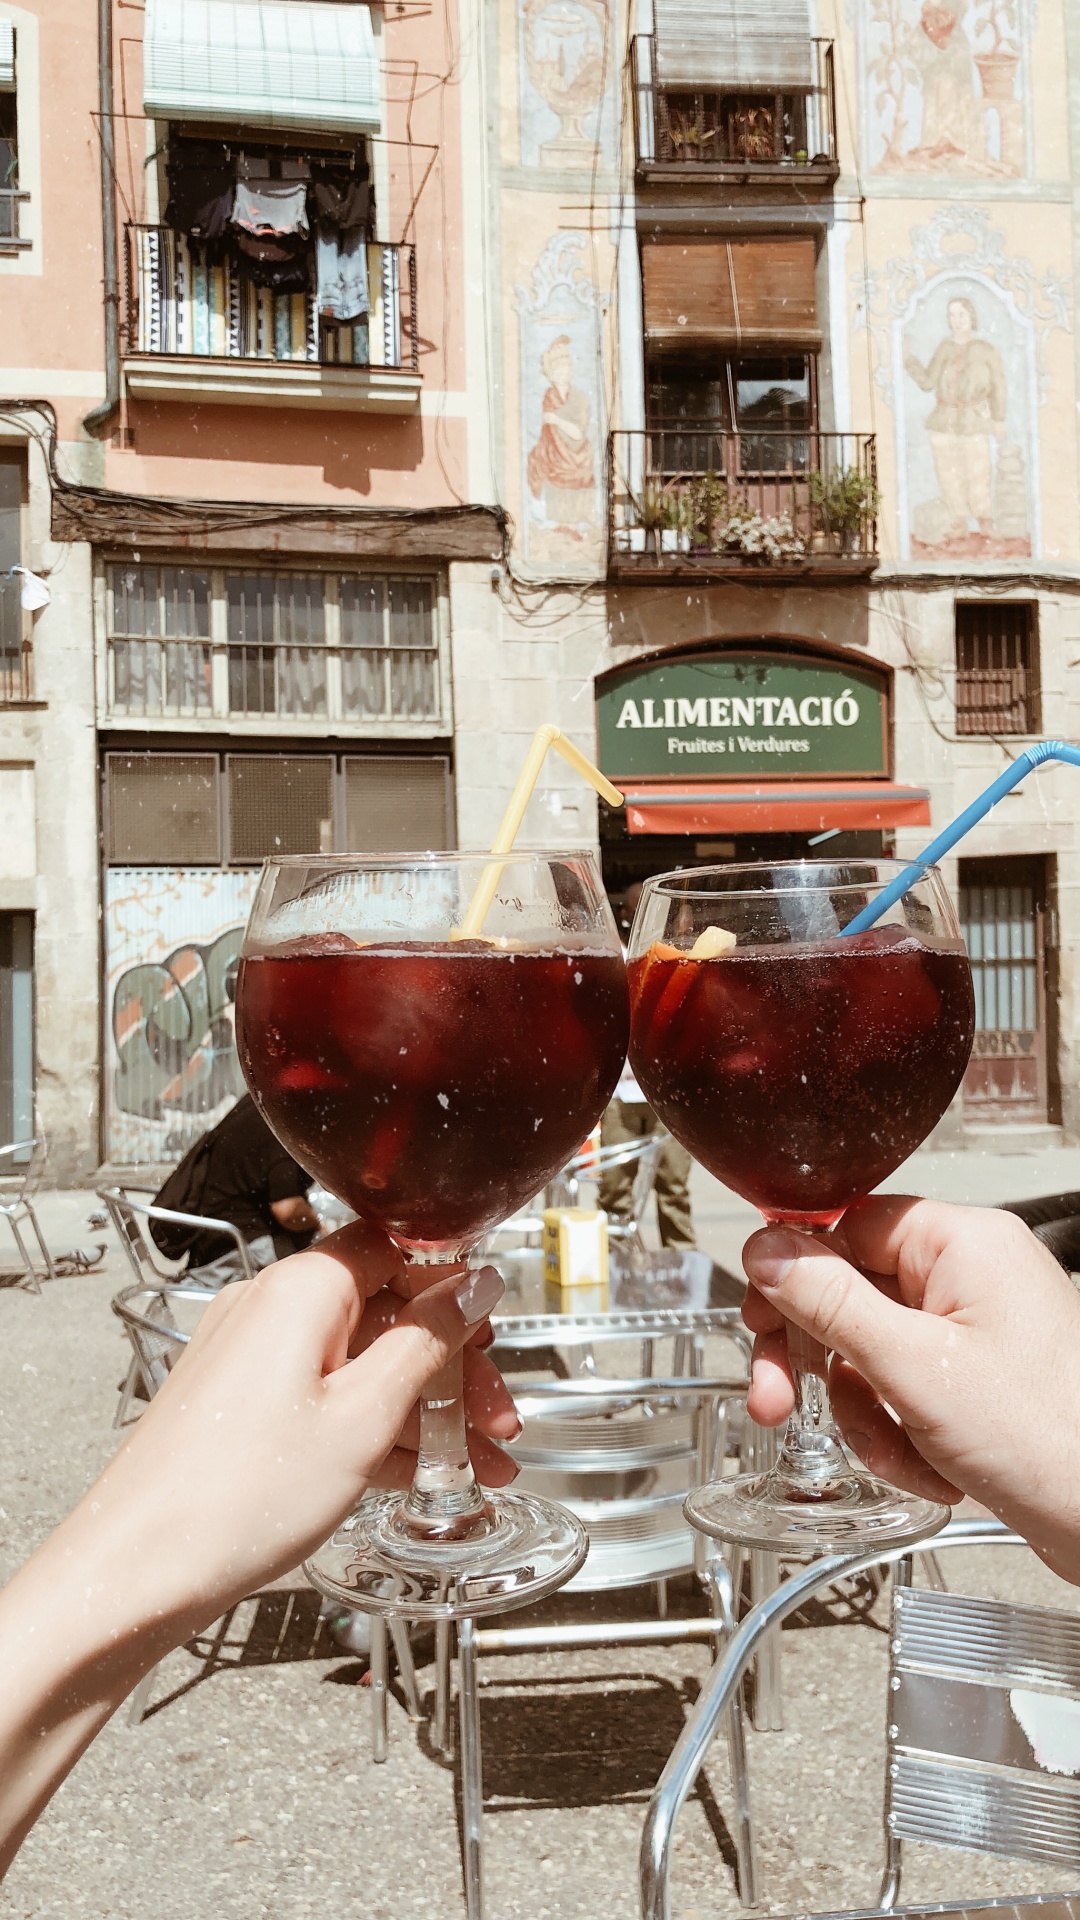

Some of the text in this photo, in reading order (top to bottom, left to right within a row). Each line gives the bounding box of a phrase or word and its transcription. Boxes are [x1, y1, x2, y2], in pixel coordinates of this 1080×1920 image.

[616, 689, 860, 728] ALIMENTACIÓ
[667, 735, 811, 754] Fruites i Verdures
